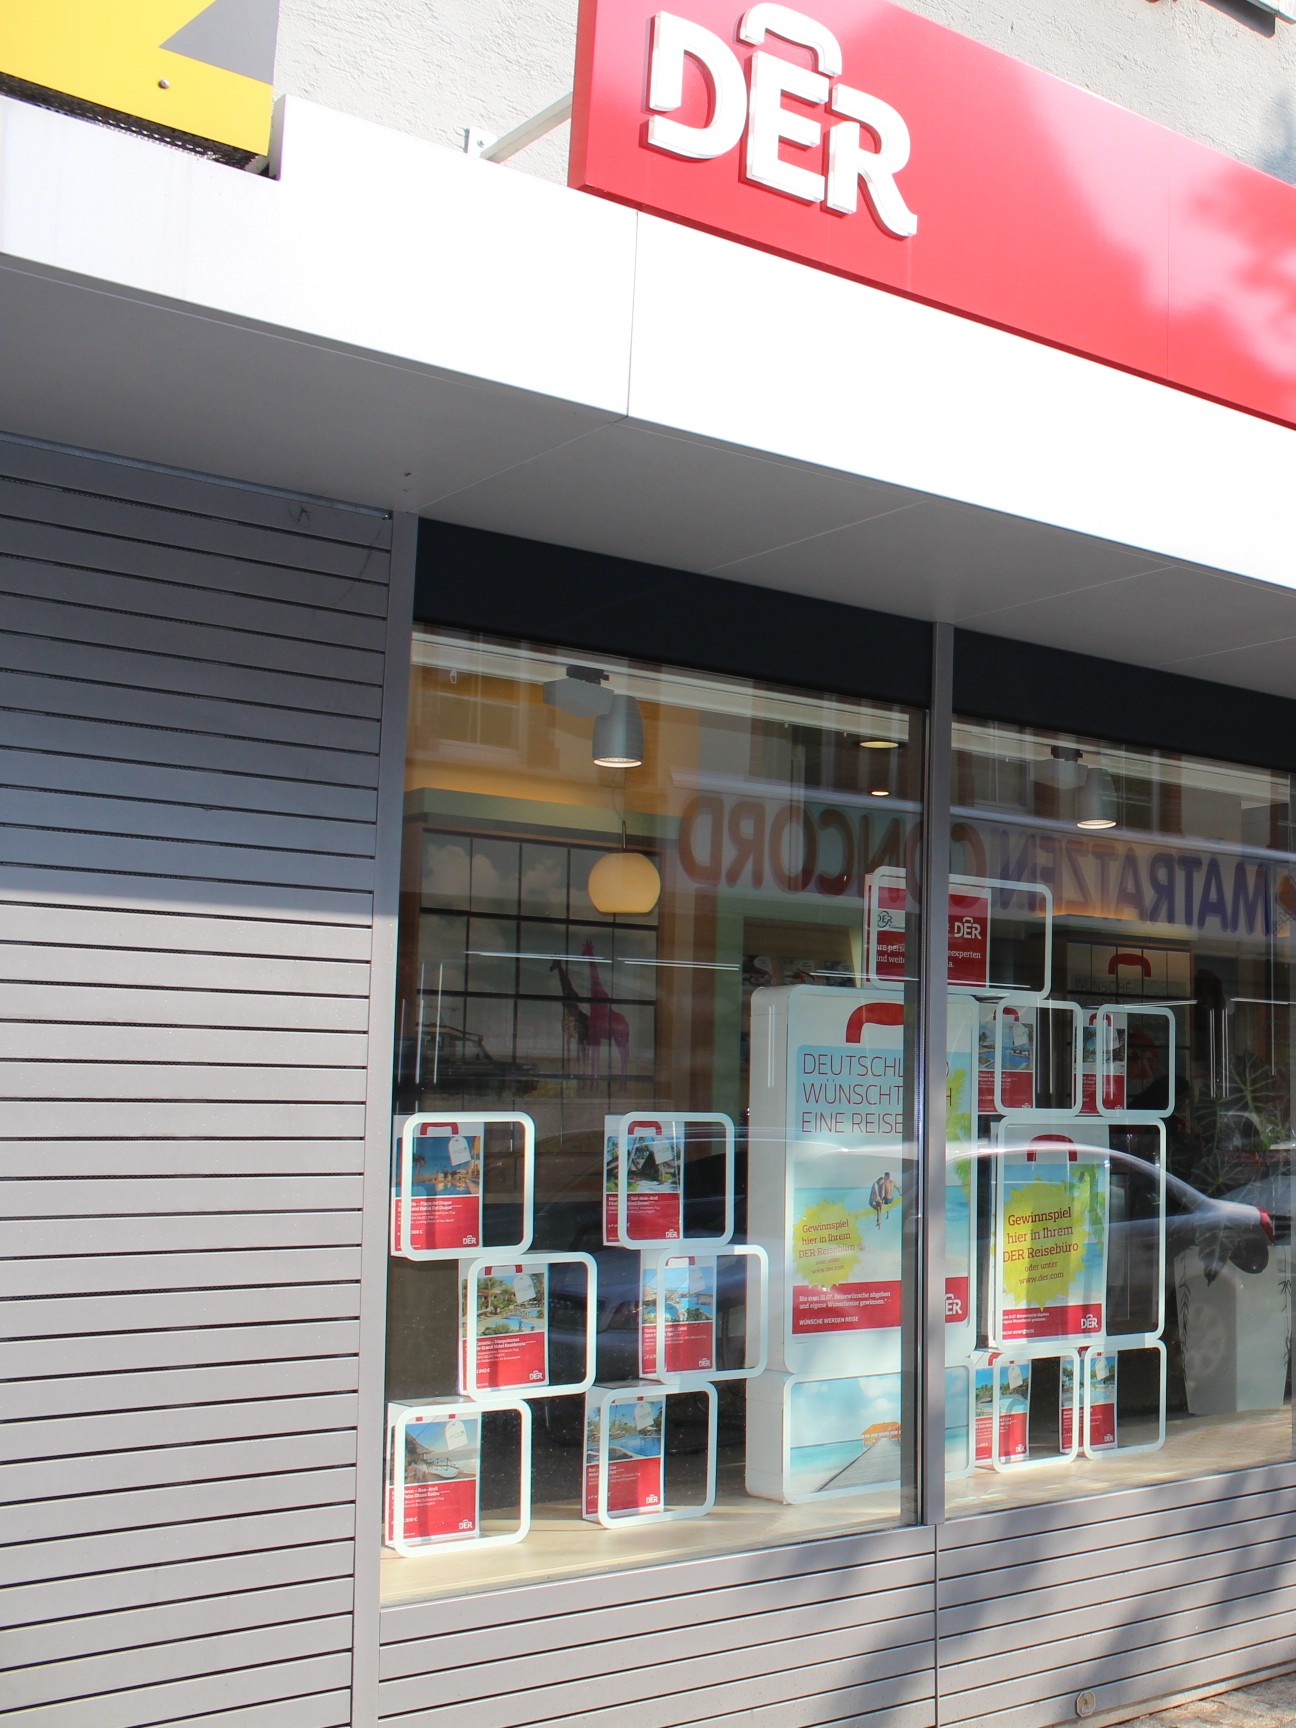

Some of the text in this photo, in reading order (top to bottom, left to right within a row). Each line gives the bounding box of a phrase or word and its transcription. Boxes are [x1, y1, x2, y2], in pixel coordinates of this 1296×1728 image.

[648, 10, 918, 237] DER
[954, 921, 981, 939] DER
[802, 1079, 904, 1106] WÜNSCHT
[801, 1112, 903, 1134] EINE REISE
[1008, 1207, 1072, 1226] Gewinnspiel
[802, 1219, 849, 1233] Gewinnspiel
[802, 1232, 851, 1246] hier in Ihrem
[1007, 1225, 1073, 1245] hier in Ihrem
[799, 1248, 815, 1258] DER
[1003, 1242, 1079, 1263] DER Reisebüro
[945, 1299, 962, 1315] ER
[1081, 1317, 1098, 1329] DER
[645, 1496, 658, 1504] DER
[459, 1522, 472, 1530] DER
